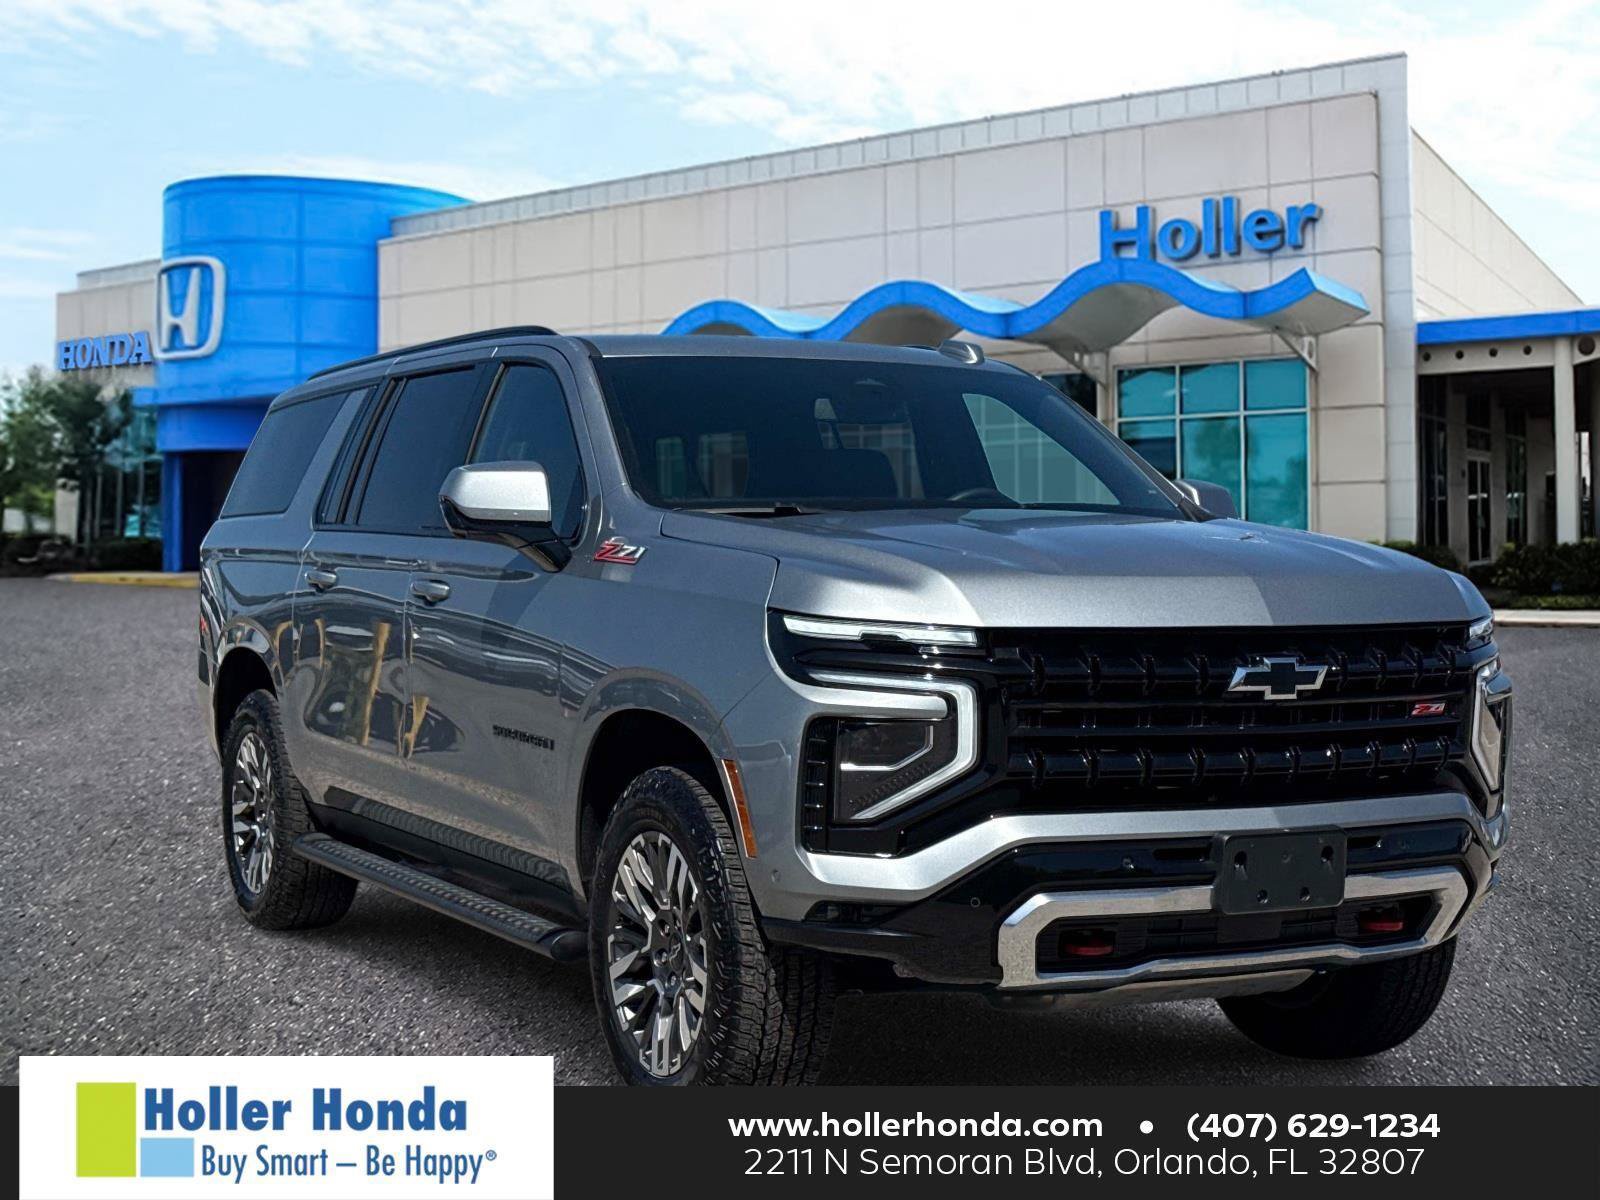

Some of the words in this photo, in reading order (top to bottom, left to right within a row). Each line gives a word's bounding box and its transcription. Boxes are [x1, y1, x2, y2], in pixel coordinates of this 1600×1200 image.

[1099, 195, 1323, 263] Holler
[57, 330, 152, 371] HONDA
[594, 540, 647, 565] Z71
